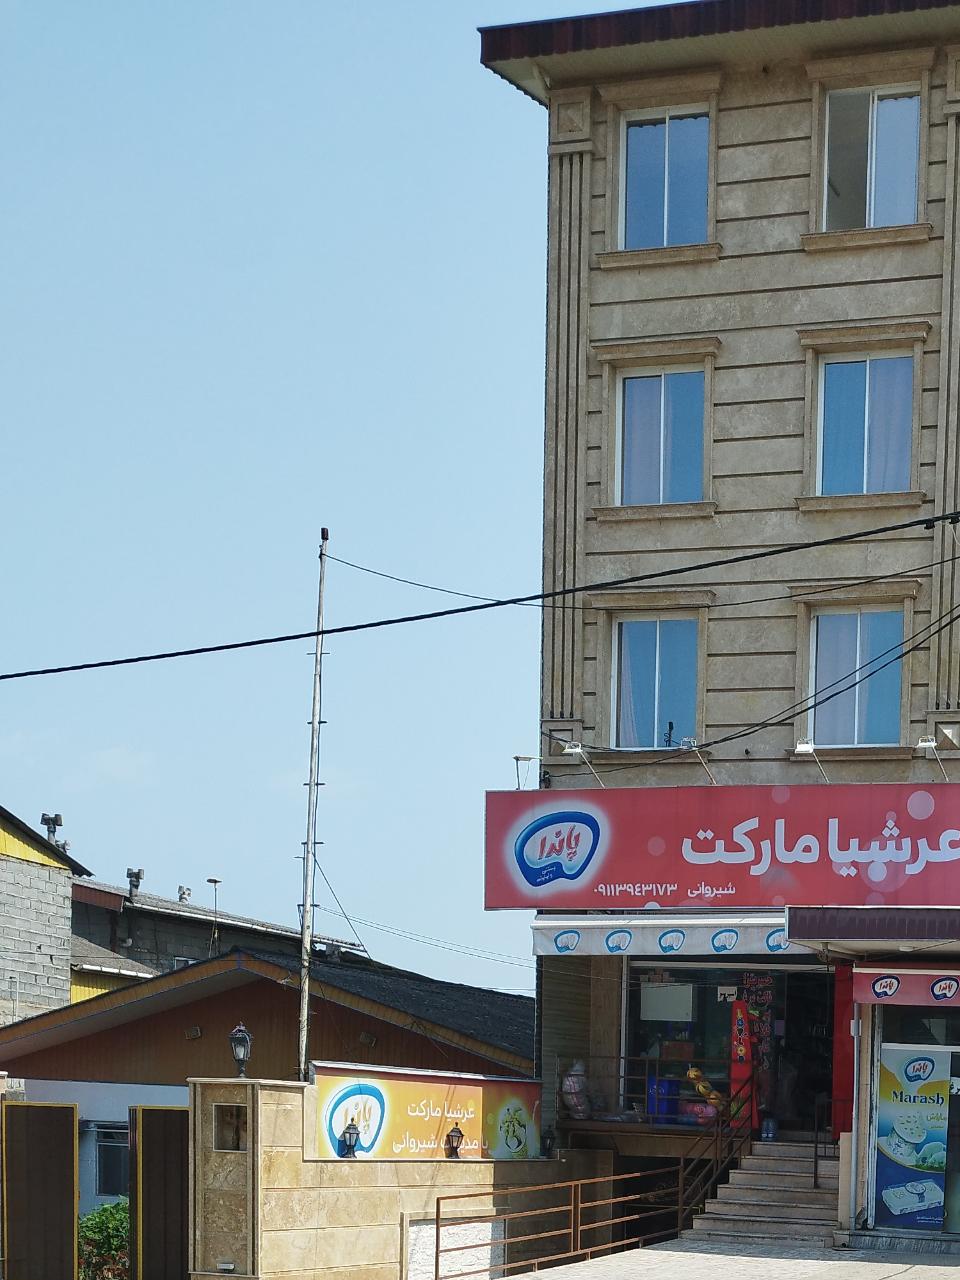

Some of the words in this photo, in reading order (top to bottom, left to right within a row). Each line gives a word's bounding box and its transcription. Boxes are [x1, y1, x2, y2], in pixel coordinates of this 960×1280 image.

[537, 824, 581, 862] پاندا
[681, 817, 820, 876] مارکت
[687, 881, 736, 898] شیروانی
[892, 1090, 945, 1107] Marash
[407, 1099, 442, 1121] مارکت
[444, 1101, 475, 1122] عرشیا
[392, 1130, 438, 1153] شیروانی
[440, 1136, 479, 1153] مدیر
